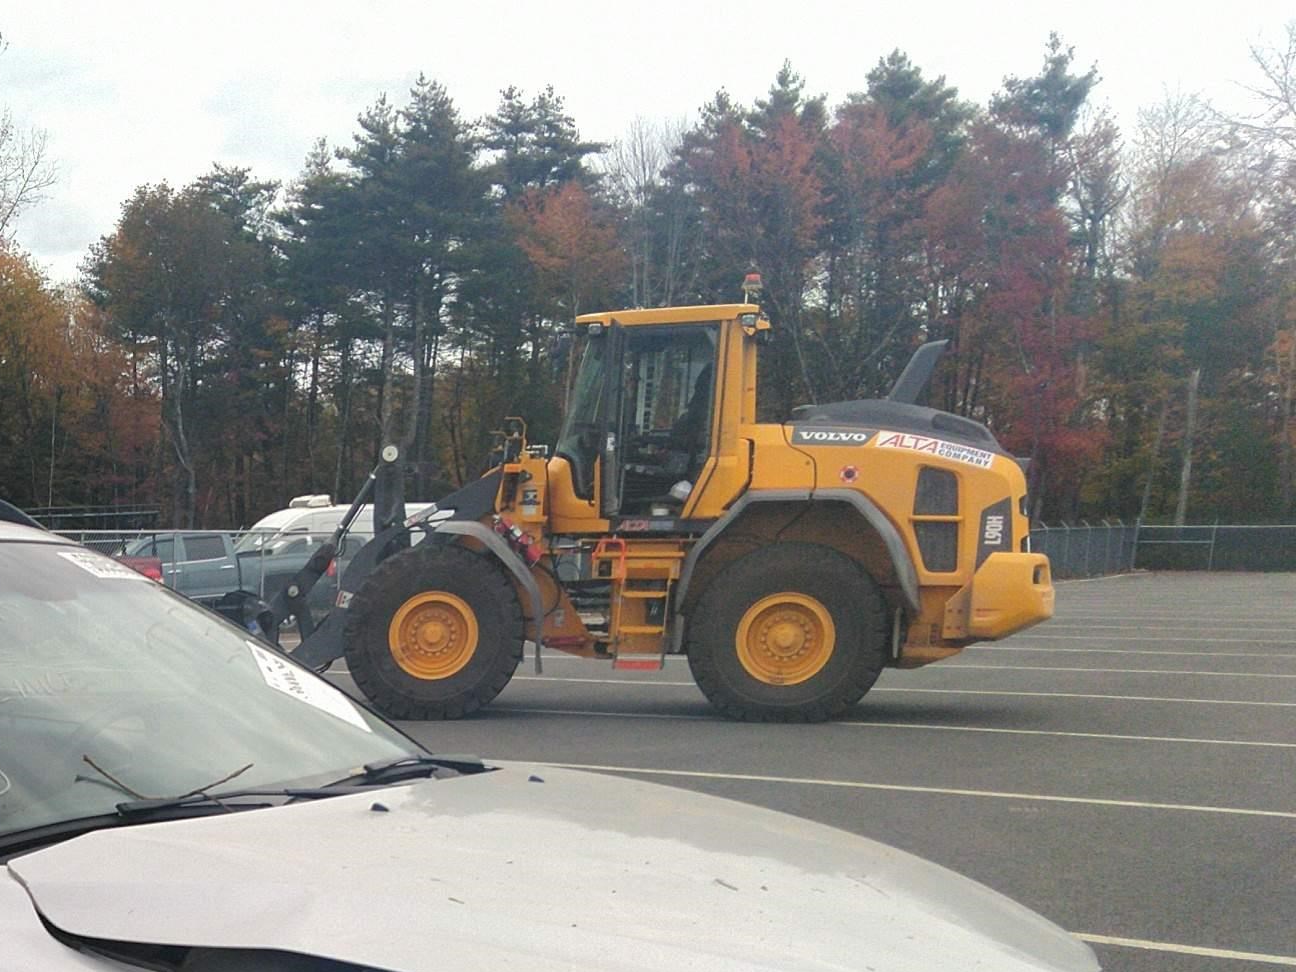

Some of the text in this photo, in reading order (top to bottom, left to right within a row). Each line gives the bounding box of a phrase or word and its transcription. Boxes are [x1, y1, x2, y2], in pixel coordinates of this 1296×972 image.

[799, 431, 867, 442] VOLVO
[880, 434, 939, 454] ALTA
[938, 449, 990, 467] COMPANY
[940, 442, 992, 460] EQUIPMENT
[984, 515, 1004, 546] L90H
